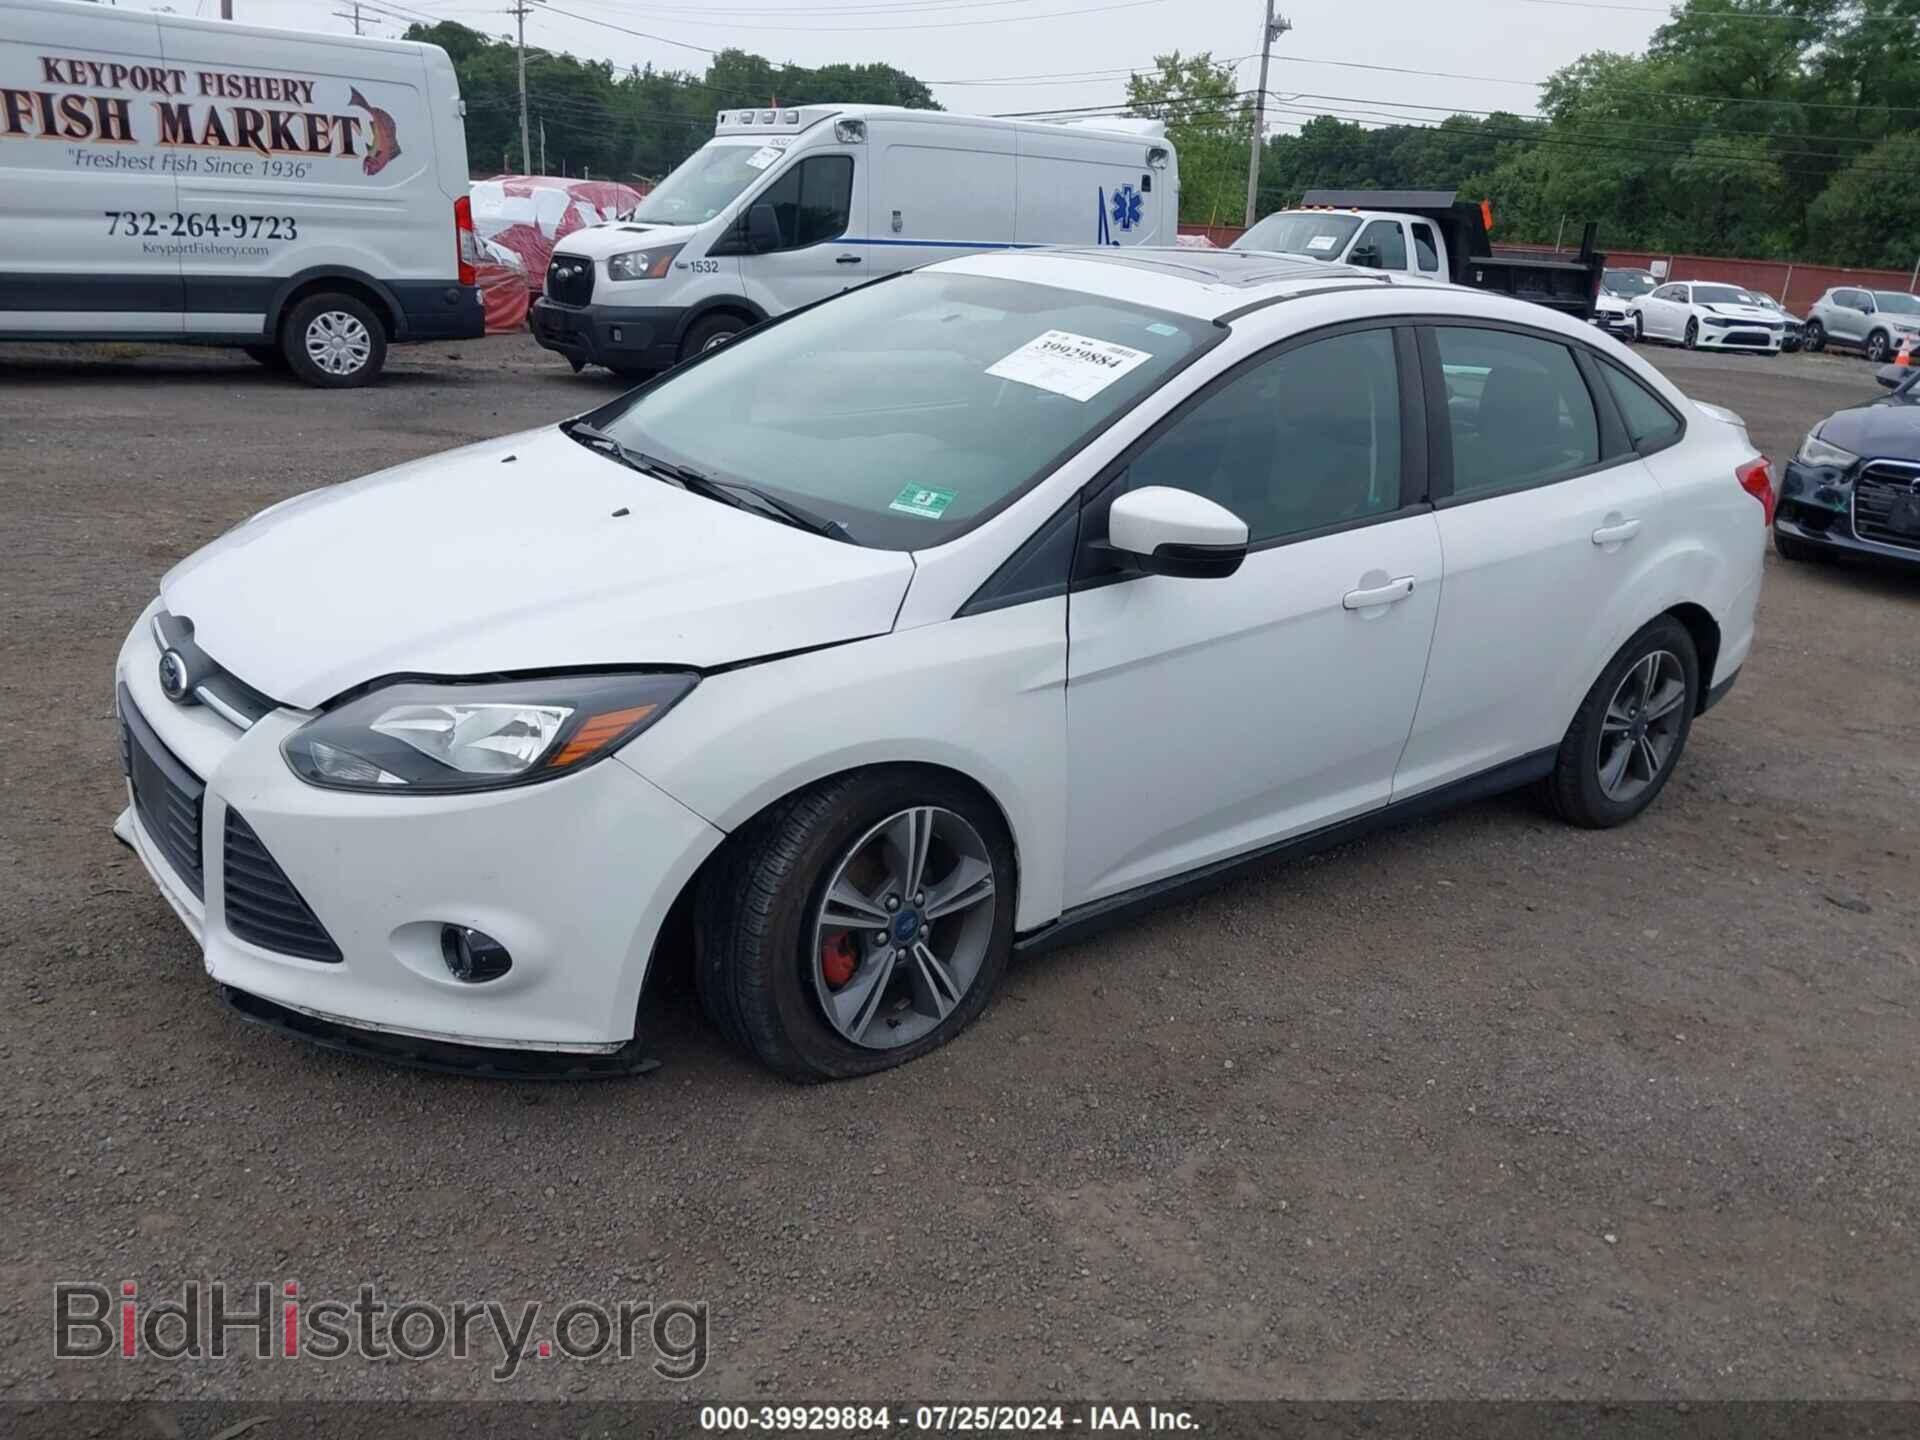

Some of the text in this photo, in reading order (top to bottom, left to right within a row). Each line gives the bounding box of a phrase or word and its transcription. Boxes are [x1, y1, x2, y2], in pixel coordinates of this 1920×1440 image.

[38, 56, 315, 107] KEYPORT FISHERY
[0, 88, 363, 158] FISH MARKET
[68, 149, 312, 179] "Freshest Fish Since 1936"
[104, 211, 298, 241] 732-264-9723
[142, 241, 270, 258] KeyportFishery.com
[690, 260, 719, 273] 1532
